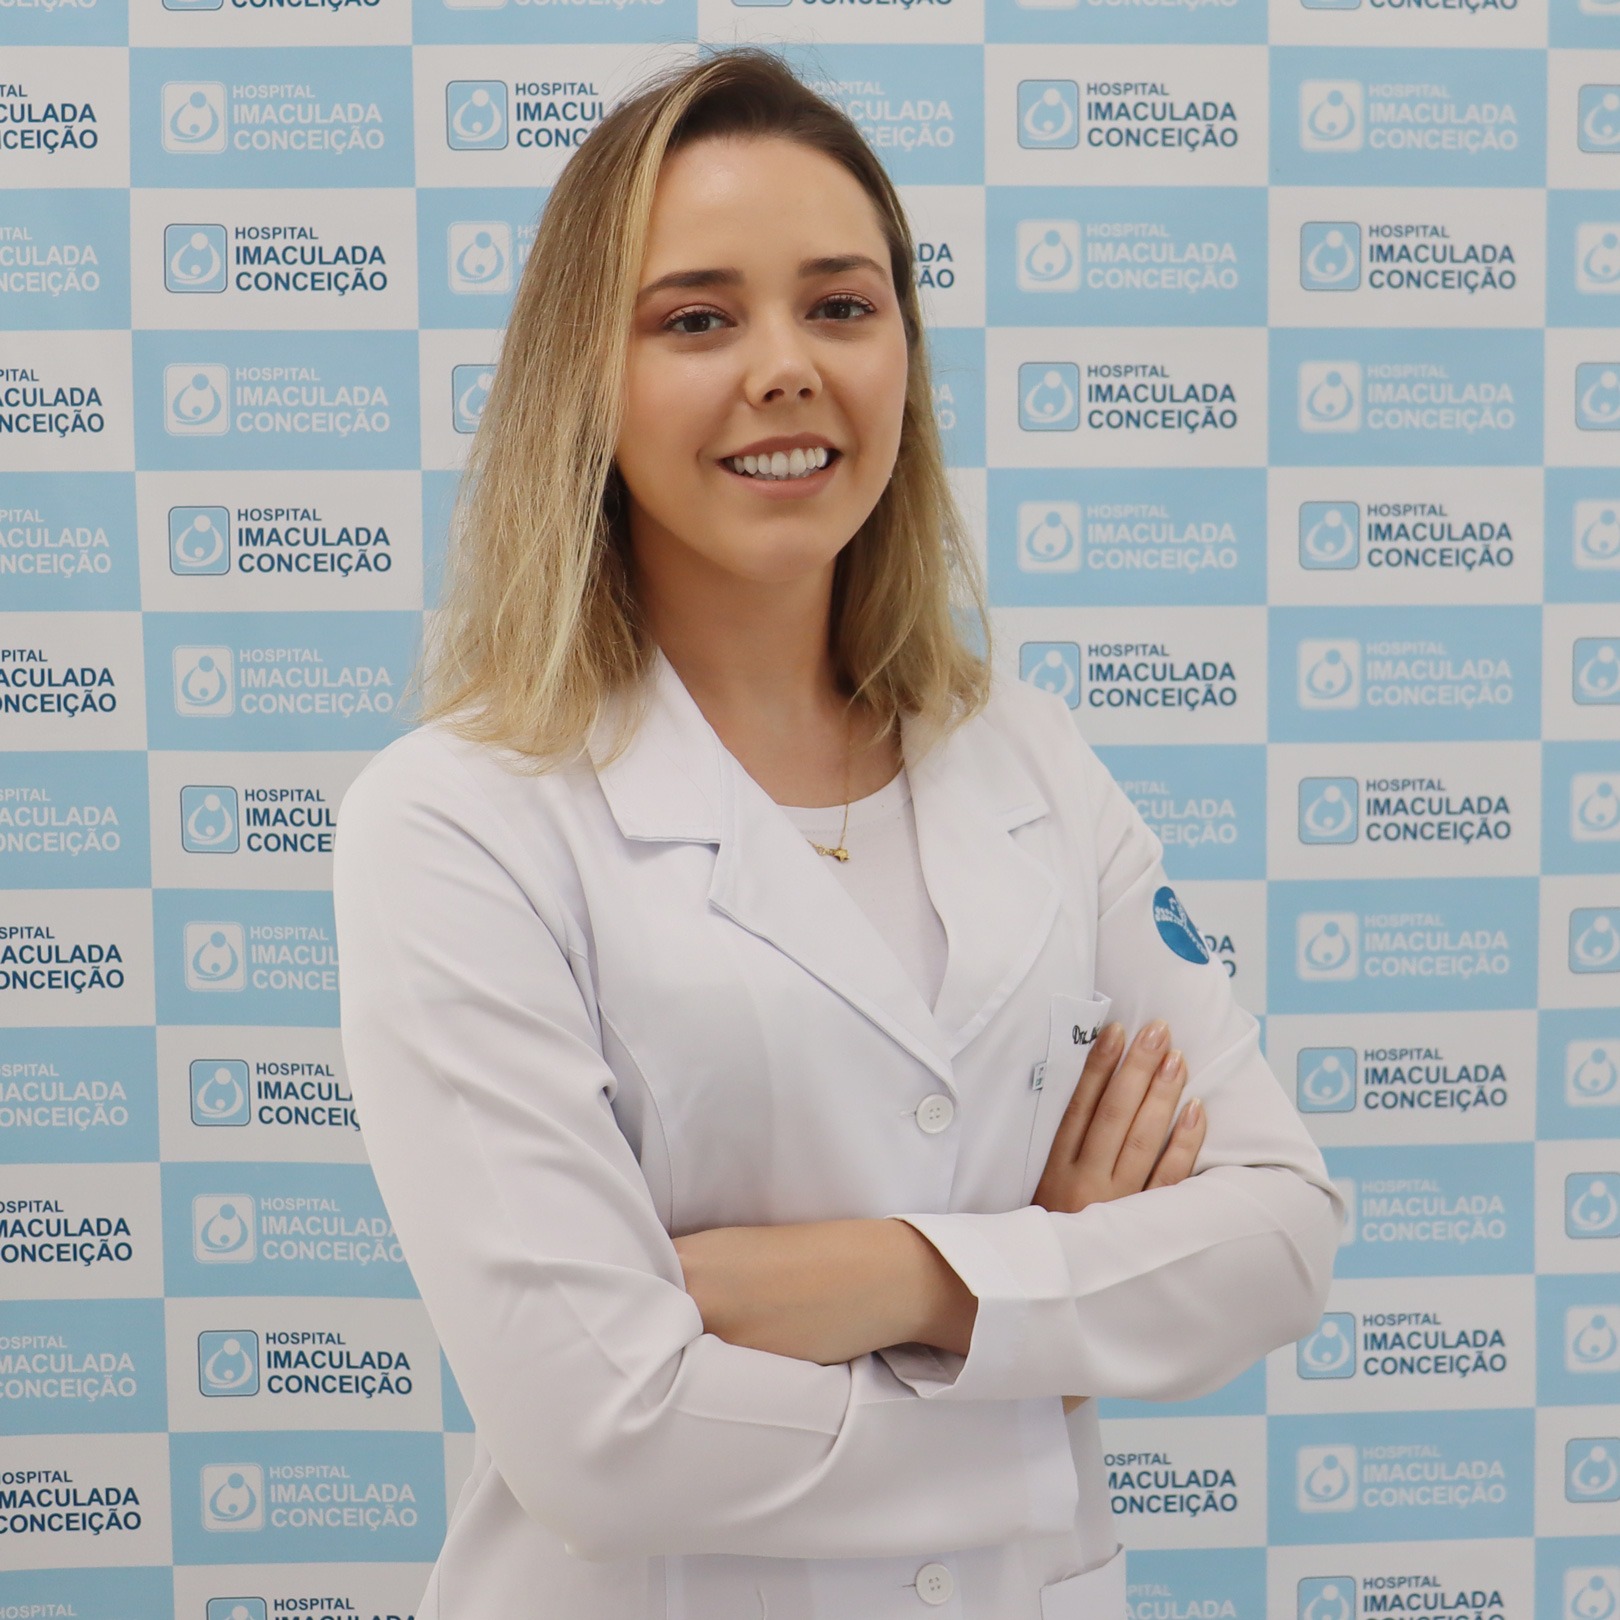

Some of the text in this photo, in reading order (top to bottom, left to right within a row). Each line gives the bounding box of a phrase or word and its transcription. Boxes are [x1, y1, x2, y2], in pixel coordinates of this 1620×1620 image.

[233, 84, 315, 98] HOSPITAL
[515, 83, 598, 96] HOSPITAL
[1088, 83, 1168, 95] HOSPITAL
[1369, 84, 1450, 98] HOSPITAL
[234, 103, 382, 124] IMACULADA
[847, 101, 953, 121] CULADA
[1088, 102, 1236, 121] IMACULADA
[1370, 103, 1517, 124] IMACULADA
[0, 126, 97, 154] CEIÇÃO
[234, 125, 384, 154] CONCEIÇÃO
[864, 124, 955, 151] CEIÇÃO
[1088, 124, 1237, 151] CONCEIÇÃO
[1370, 125, 1518, 153] CONCEIÇÃO
[0, 227, 32, 240] ITAL
[236, 227, 318, 239] HOSPITAL
[1087, 224, 1168, 236] HOSPITAL
[1369, 225, 1448, 237] HOSPITAL
[0, 245, 97, 266] CULADA
[236, 246, 385, 265] IMACULADA
[1088, 243, 1236, 263] IMACULADA
[1369, 244, 1514, 263] IMACULADA
[0, 268, 99, 296] NCEIÇÃO
[236, 268, 387, 295] CONCEIÇÃO
[1088, 265, 1237, 292] CONCEIÇÃO
[1369, 267, 1516, 293] CONCEIÇÃO
[236, 368, 319, 380] HOSPITAL
[1088, 365, 1168, 377] HOSPITAL
[1368, 365, 1448, 378] HOSPITAL
[0, 388, 102, 407] CULADA
[237, 386, 388, 406] IMACULADA
[1089, 384, 1235, 403] IMACULADA
[1368, 384, 1514, 404] IMACULADA
[0, 410, 104, 437] NCEIÇÃO
[237, 408, 390, 436] CONCEIÇÃO
[1088, 406, 1237, 433] CONCEIÇÃO
[1368, 405, 1515, 433] CONCEIÇÃO
[0, 510, 43, 522] PITAL
[238, 509, 321, 521] HOSPITAL
[1088, 505, 1168, 518] HOSPITAL
[1368, 504, 1446, 516] HOSPITAL
[239, 528, 390, 546] IMACULADA
[1088, 523, 1235, 543] IMACULADA
[1368, 523, 1511, 541] IMACULADA
[0, 550, 112, 578] NCEIÇÃO
[239, 549, 391, 577] CONCEIÇÃO
[1088, 545, 1237, 572] CONCEIÇÃO
[1368, 545, 1513, 570] CONCEIÇÃO
[2, 650, 47, 662] PITAL
[240, 649, 322, 662] HOSPITAL
[1089, 645, 1168, 656] HOSPITAL
[1367, 642, 1445, 655] HOSPITAL
[0, 668, 114, 687] ACULADA
[241, 667, 392, 688] IMACULADA
[1089, 662, 1235, 681] IMACULADA
[1367, 660, 1511, 681] IMACULADA
[0, 690, 116, 717] NCEIÇÃO
[241, 689, 393, 717] CONCEIÇÃO
[1089, 684, 1236, 710] CONCEIÇÃO
[1367, 683, 1512, 708] CONCEIÇÃO
[0, 788, 50, 801] SPITAL
[1367, 779, 1444, 791] HOSPITAL
[245, 789, 325, 802] HOSPITAL
[1134, 799, 1236, 819] CULADA
[1367, 796, 1509, 816] IMACULADA
[0, 807, 118, 826] ACULADA
[246, 808, 336, 828] IMACUL
[1366, 818, 1511, 844] CONCEIÇÃO
[0, 828, 120, 856] NCEIÇÃO
[247, 833, 336, 852] CONCE
[1365, 914, 1443, 927] HOSPITAL
[0, 927, 54, 939] SPITAL
[250, 927, 328, 941] HOSPITAL
[1366, 931, 1508, 951] IMACULADA
[0, 945, 122, 964] ACULADA
[251, 945, 339, 965] IMACUL
[1365, 952, 1509, 978] CONCEIÇÃO
[0, 966, 124, 993] ONCEIÇÃO
[252, 970, 338, 990] CONCE
[1365, 1048, 1443, 1061] HOSPITAL
[2, 1064, 59, 1076] SPITAL
[257, 1063, 334, 1077] HOSPITAL
[1365, 1065, 1506, 1085] IMACULADA
[0, 1081, 126, 1102] ACULADA
[258, 1081, 352, 1101] IMACUL
[1364, 1086, 1507, 1111] CONCEIÇÃO
[0, 1103, 128, 1131] ONCEIÇÃO
[1364, 1181, 1441, 1193] HOSPITAL
[261, 1198, 341, 1212] HOSPITAL
[1364, 1196, 1506, 1217] IMACULADA
[1364, 1218, 1507, 1243] CONCEIÇÃO
[1, 1239, 132, 1266] ONCEIÇÃO
[1364, 1313, 1440, 1326] HOSPITAL
[0, 1336, 66, 1349] OSPITAL
[266, 1332, 345, 1344] HOSPITAL
[1364, 1330, 1505, 1350] IMACULADA
[0, 1353, 135, 1374] MACULADA
[267, 1351, 410, 1370] IMACULADA
[1364, 1351, 1506, 1377] CONCEIÇÃO
[0, 1375, 136, 1401] ONCEIÇÃO
[268, 1372, 412, 1398] CONCEIÇÃO
[1104, 1454, 1170, 1466] OSPITAL
[1364, 1446, 1439, 1458] HOSPITAL
[2, 1471, 72, 1484] OSPITAL
[270, 1466, 350, 1478] HOSPITAL
[1109, 1470, 1236, 1489] MACULADA
[1364, 1461, 1504, 1482] IMACULADA
[0, 1488, 139, 1511] MACULADA
[271, 1484, 415, 1503] IMACULADA
[1364, 1482, 1506, 1507] CONCEIÇÃO
[1111, 1491, 1237, 1517] ONCEIÇÃO
[271, 1504, 417, 1531] CONCEIÇÃO
[1127, 1583, 1172, 1597] PITAL
[1364, 1576, 1440, 1589] HOSPITAL
[274, 1598, 354, 1611] HOSPITAL
[1125, 1600, 1236, 1619] ACULADA
[1364, 1591, 1504, 1612] IMACULADA
